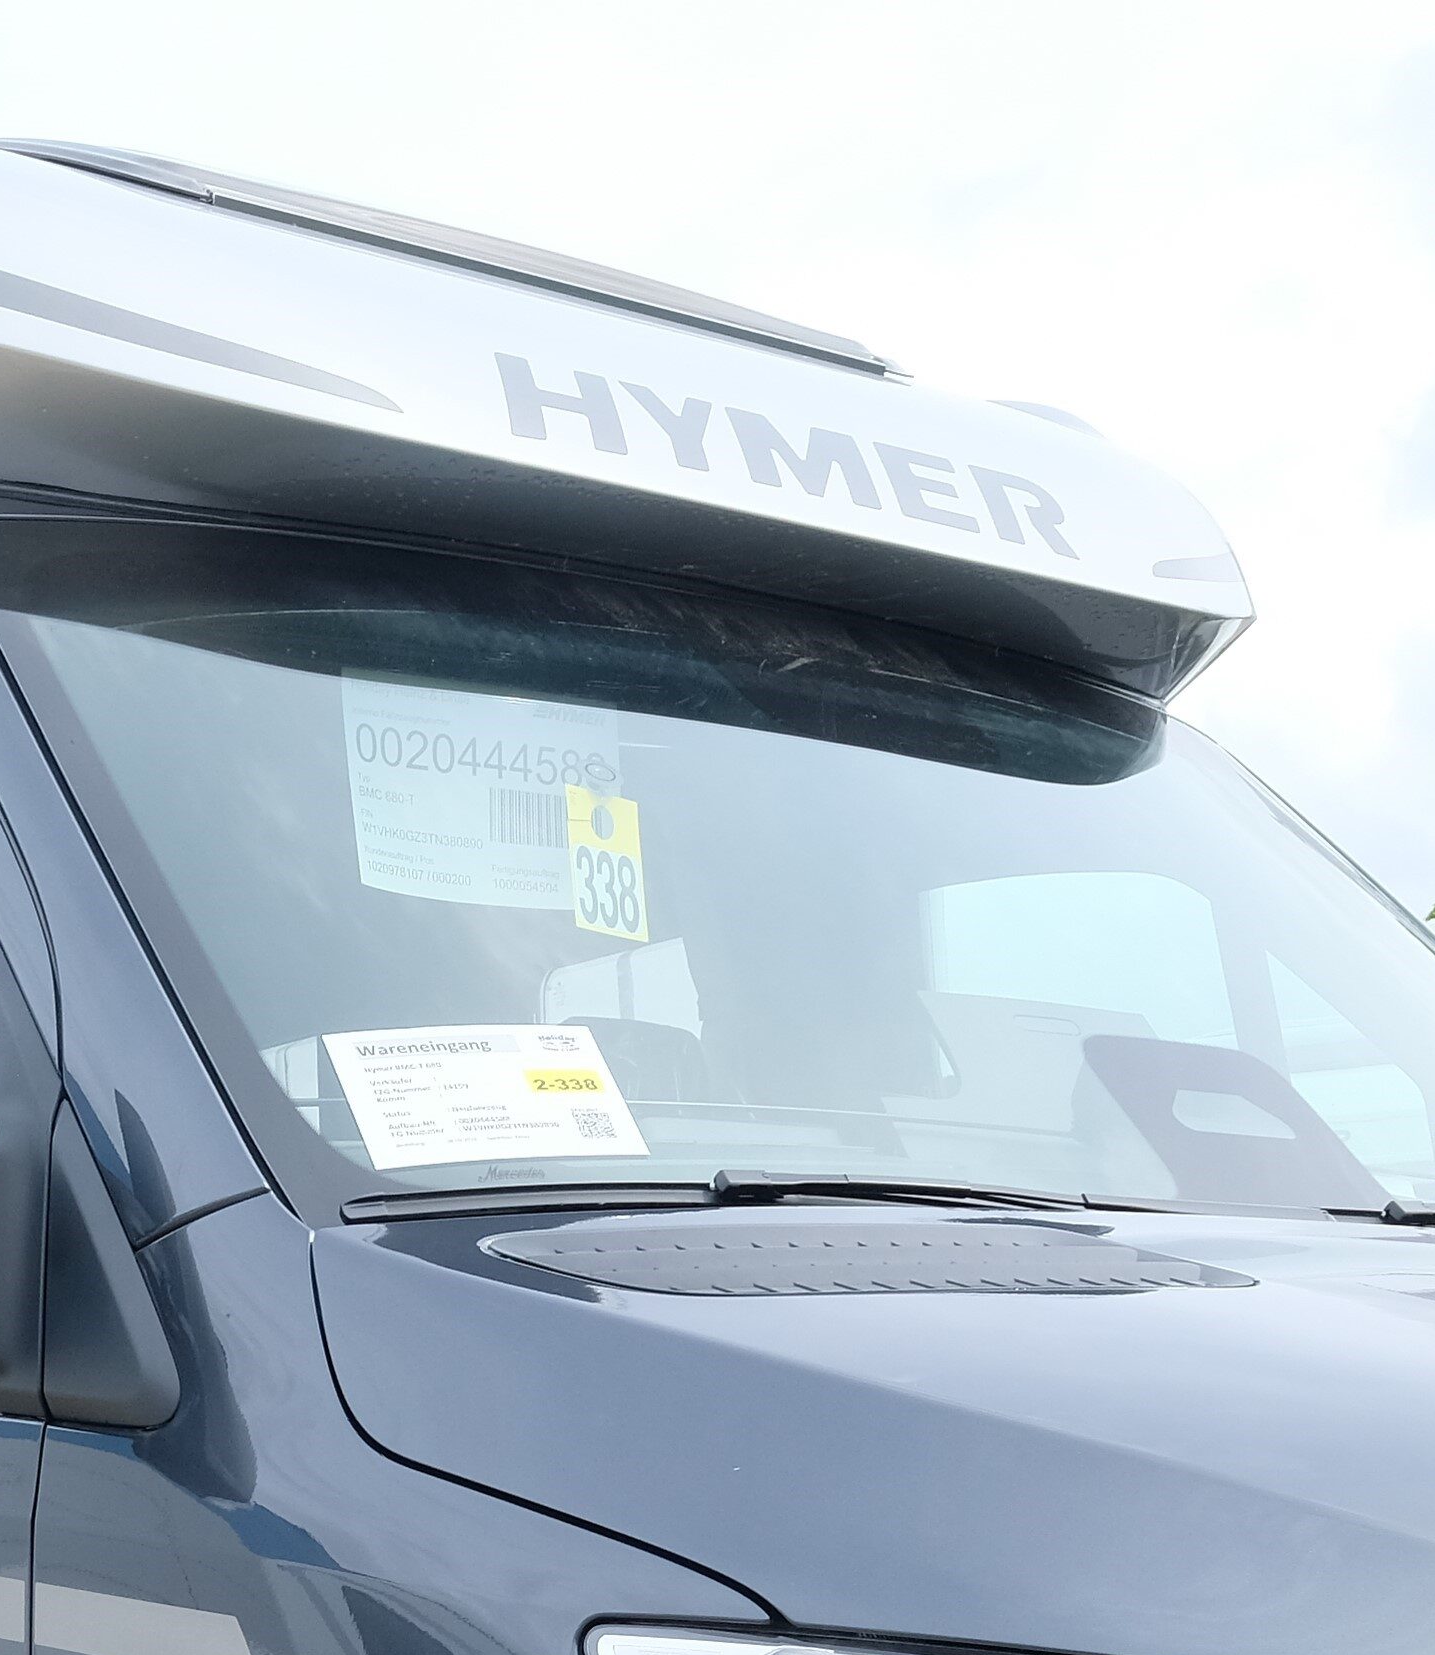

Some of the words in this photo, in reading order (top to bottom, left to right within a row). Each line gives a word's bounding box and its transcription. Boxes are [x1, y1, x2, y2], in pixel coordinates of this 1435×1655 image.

[493, 351, 1080, 560] HYMER
[576, 844, 641, 933] 338
[356, 1038, 493, 1058] Wareneingang
[532, 1077, 599, 1092] 2-338
